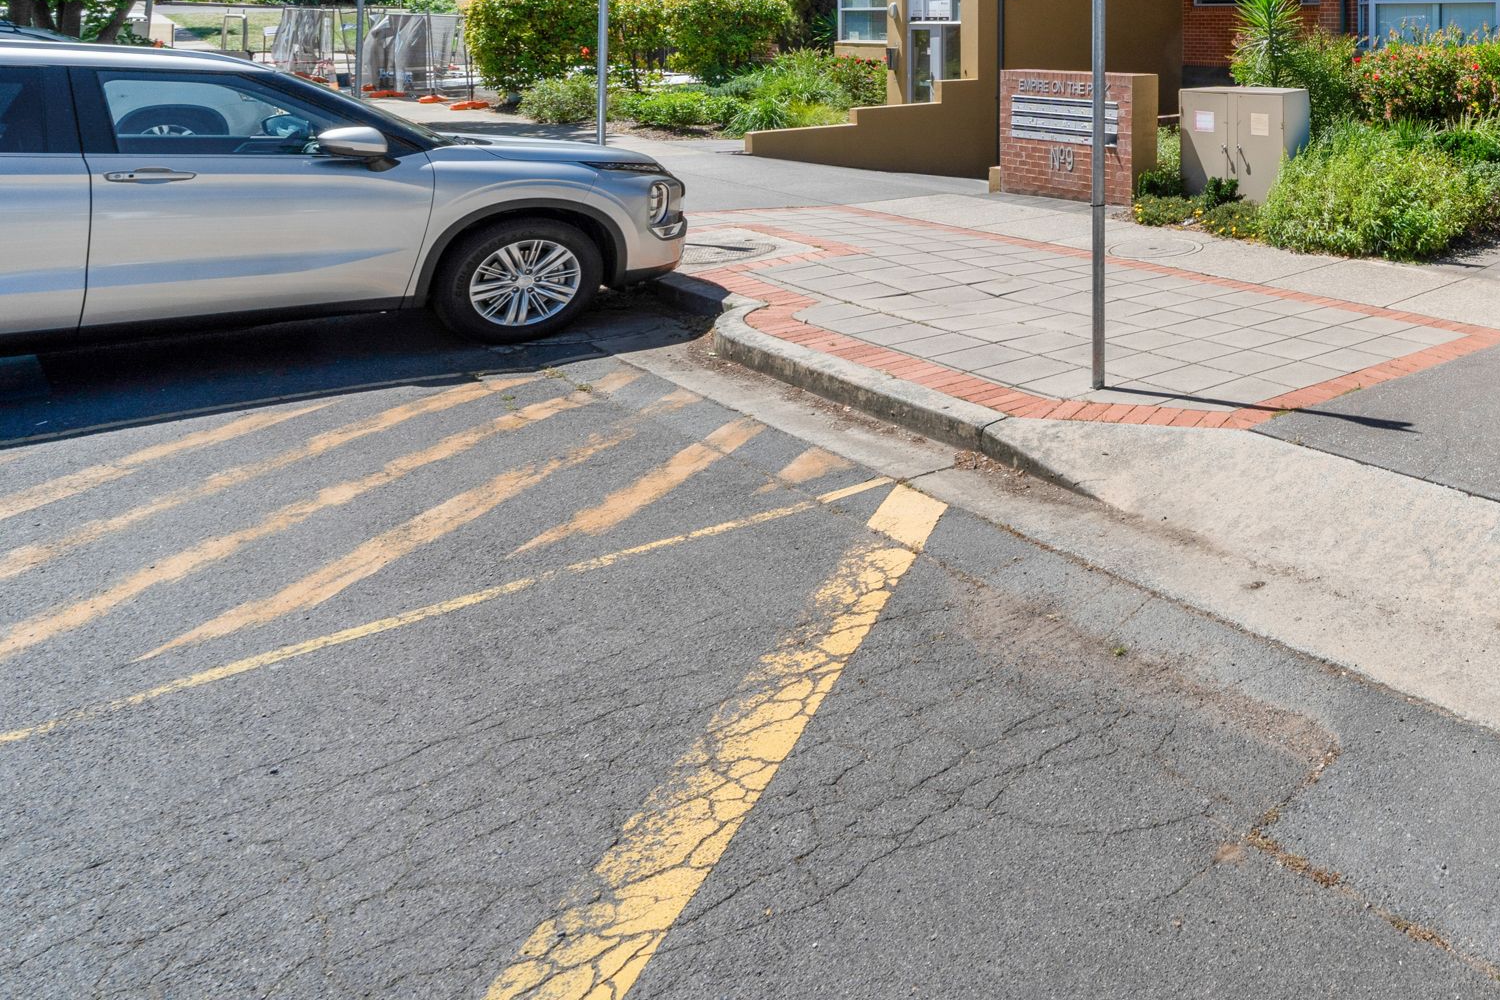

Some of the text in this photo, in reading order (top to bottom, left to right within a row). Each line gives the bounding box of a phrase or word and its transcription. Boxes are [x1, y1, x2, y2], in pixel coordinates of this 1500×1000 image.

[1018, 79, 1050, 94] EMPIRE
[1051, 80, 1065, 95] ON
[1067, 81, 1086, 97] THE
